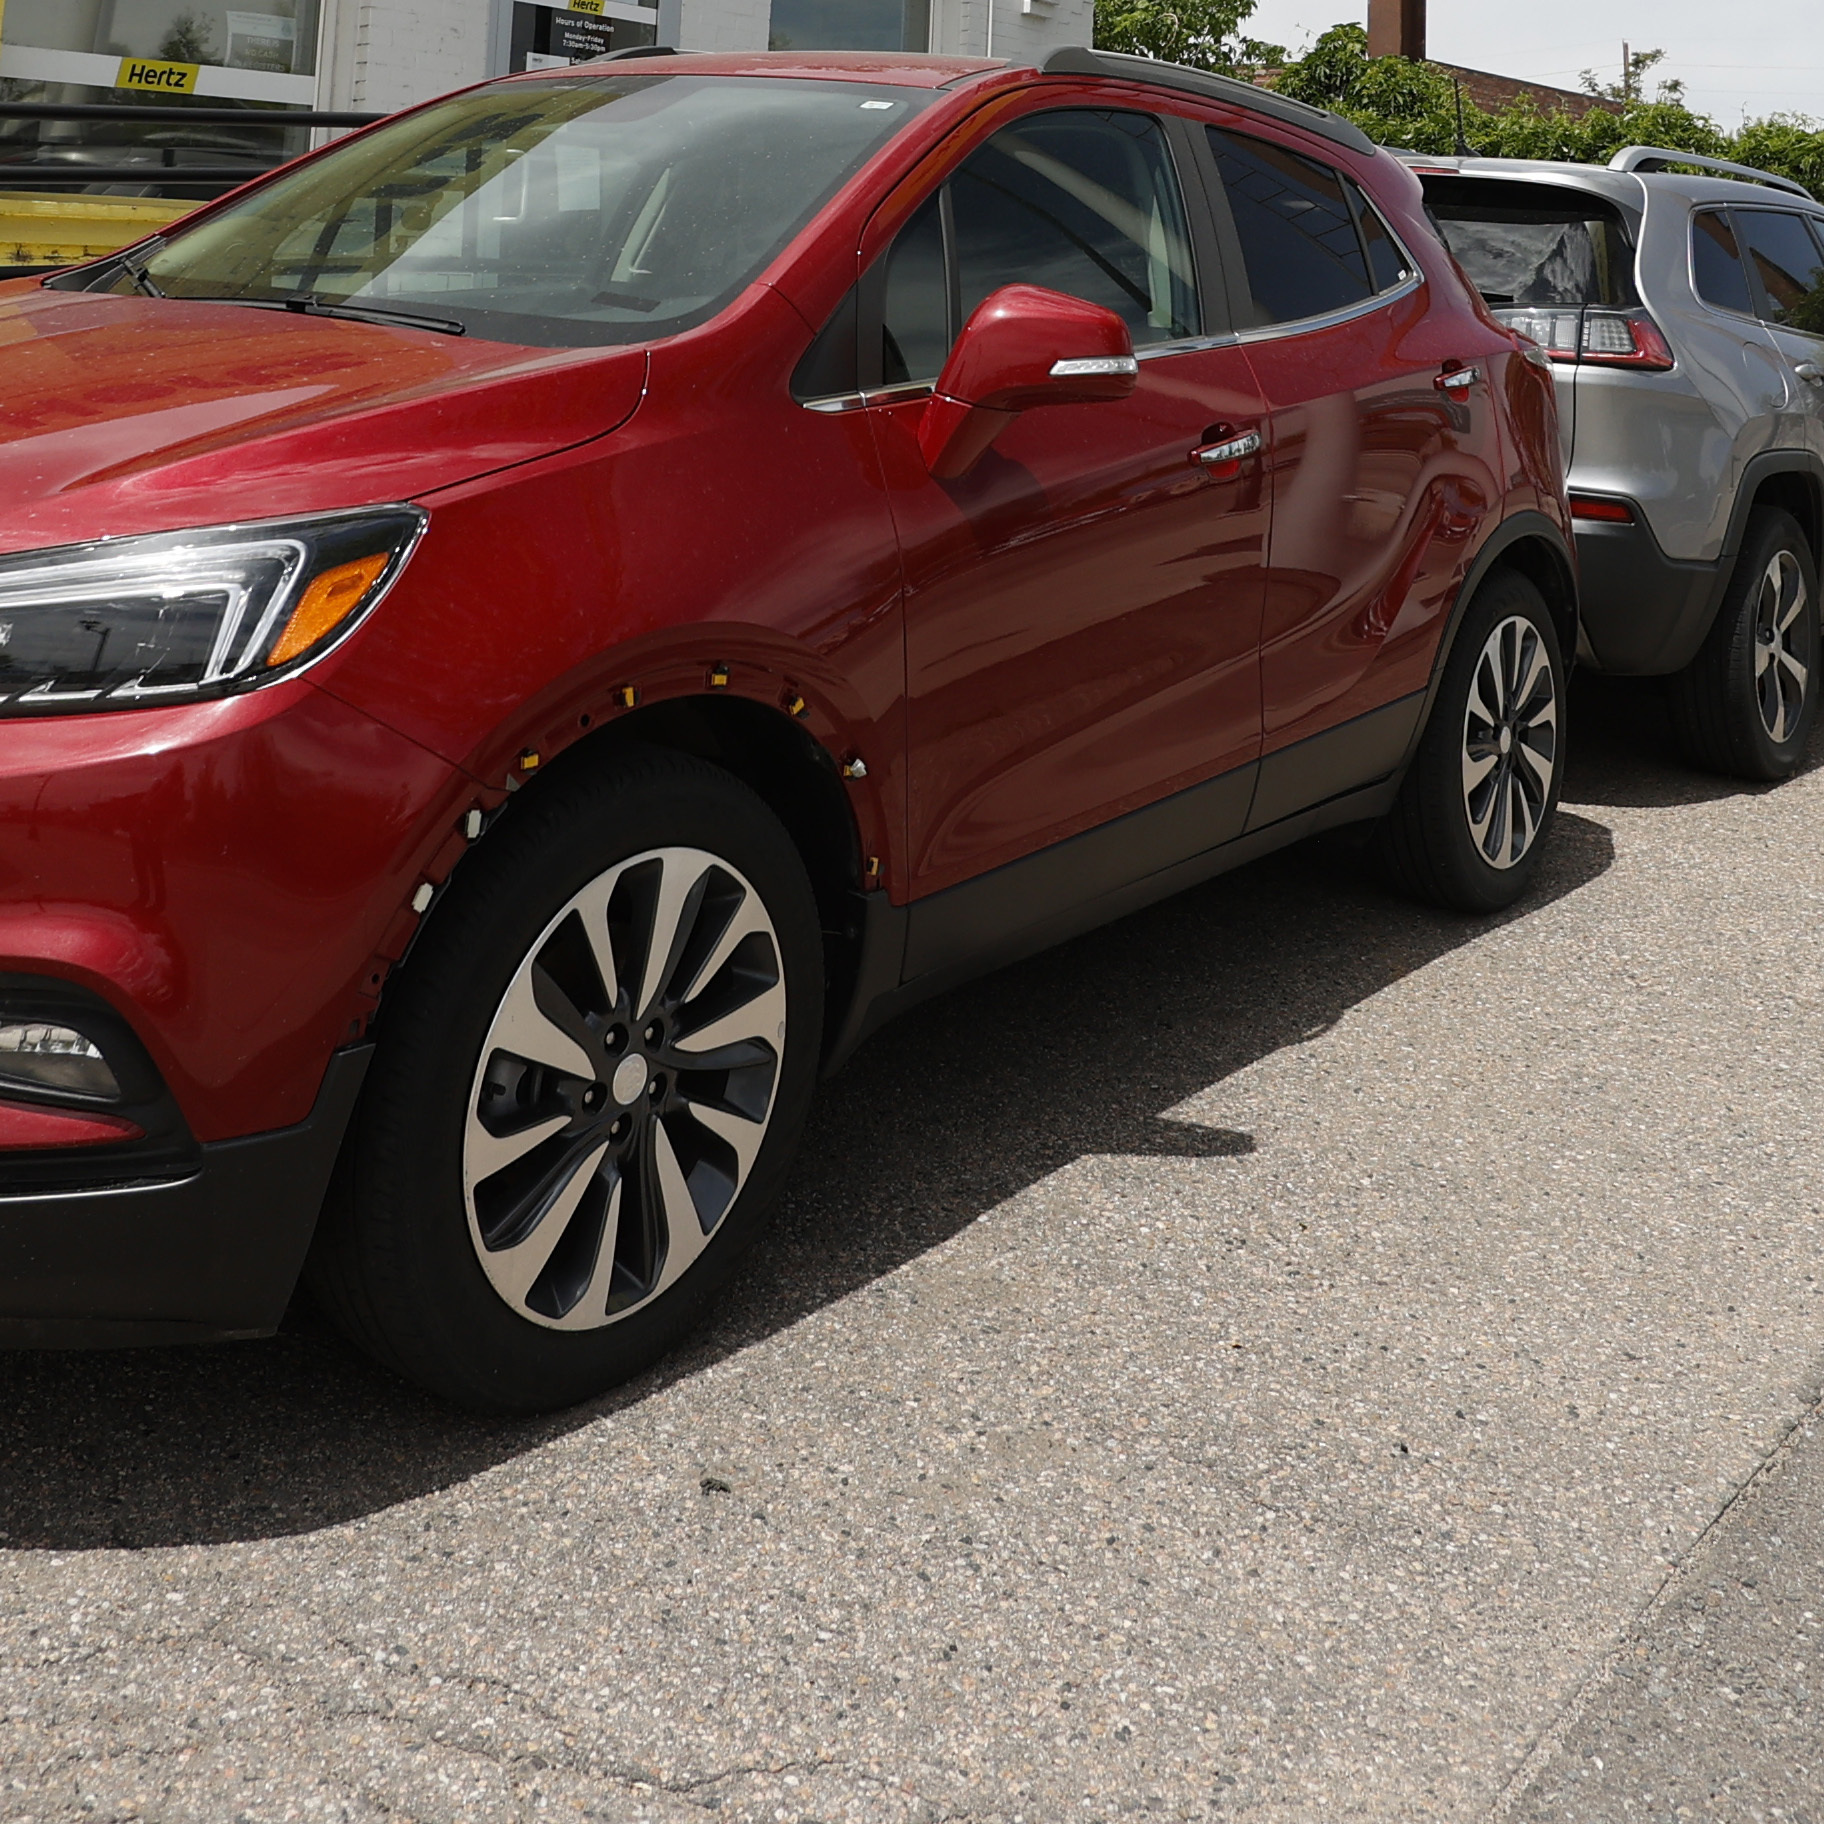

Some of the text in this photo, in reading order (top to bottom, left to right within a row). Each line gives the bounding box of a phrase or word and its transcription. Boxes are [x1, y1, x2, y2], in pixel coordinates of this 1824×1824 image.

[556, 17, 615, 33] Hours of Operation
[564, 32, 604, 44] Monday-Friday
[128, 64, 188, 87] Hertz
